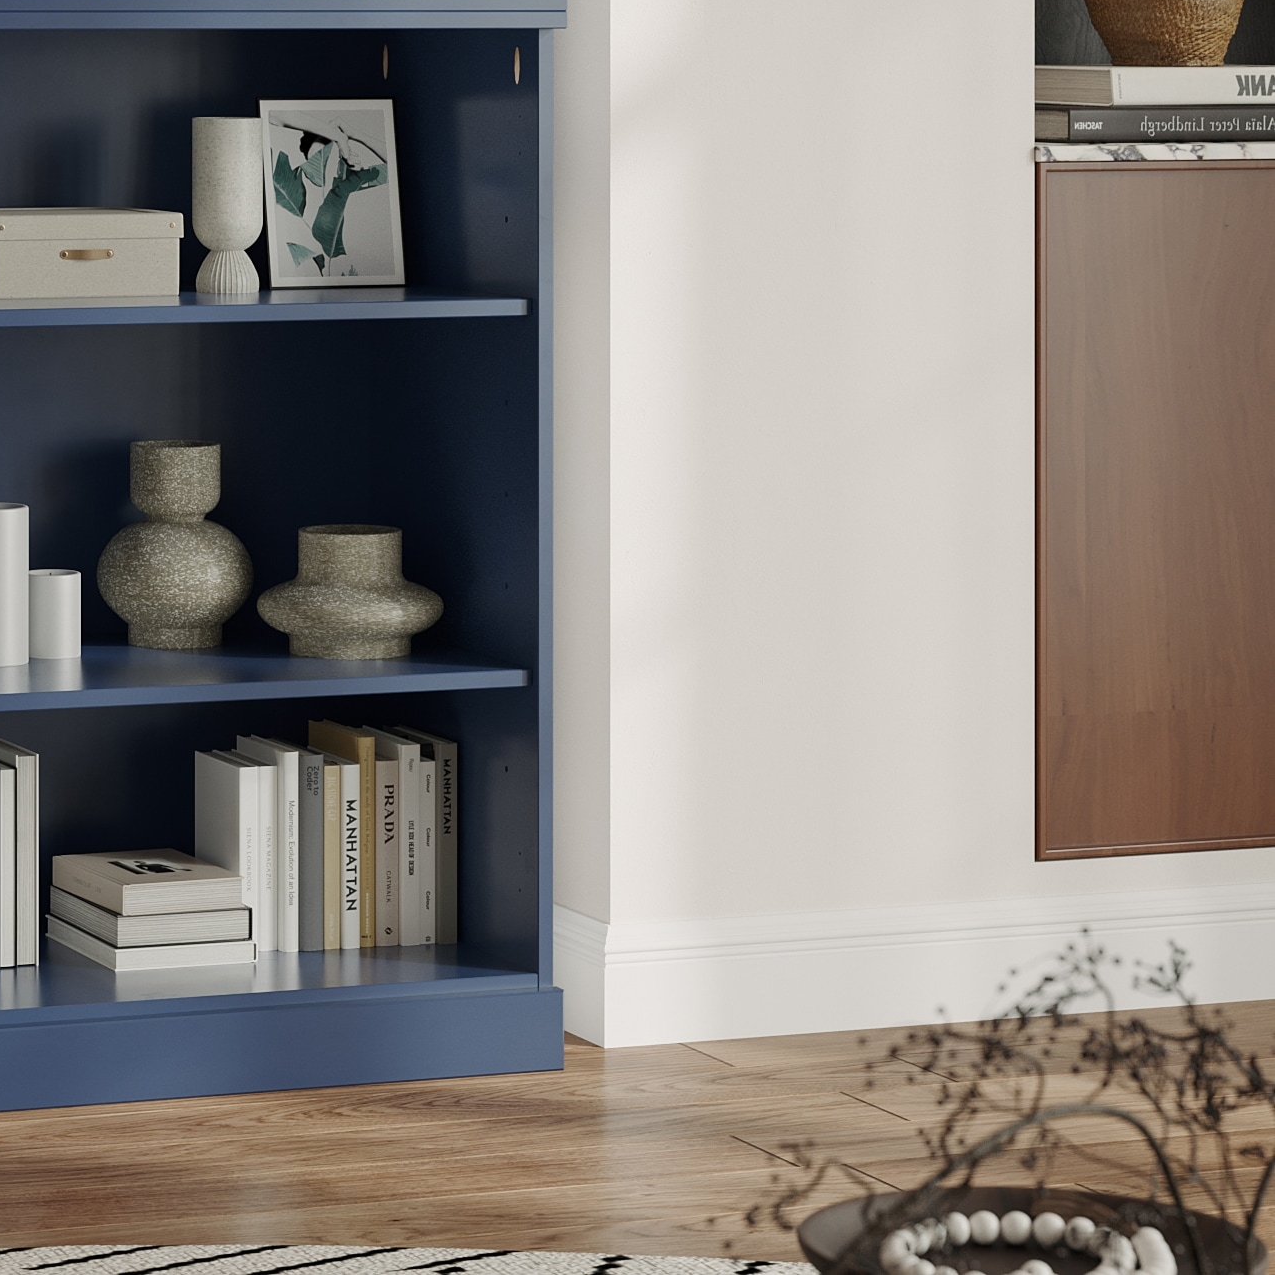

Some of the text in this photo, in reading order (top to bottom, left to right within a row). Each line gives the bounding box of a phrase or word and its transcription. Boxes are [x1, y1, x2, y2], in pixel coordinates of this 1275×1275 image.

[313, 786, 319, 796] to
[444, 758, 452, 835] MANHATTAN
[288, 800, 296, 840] Modernism:
[384, 784, 394, 845] PRADA
[288, 841, 296, 873] Evolution
[346, 799, 357, 911] MANHATTAN
[288, 891, 296, 906] Idea
